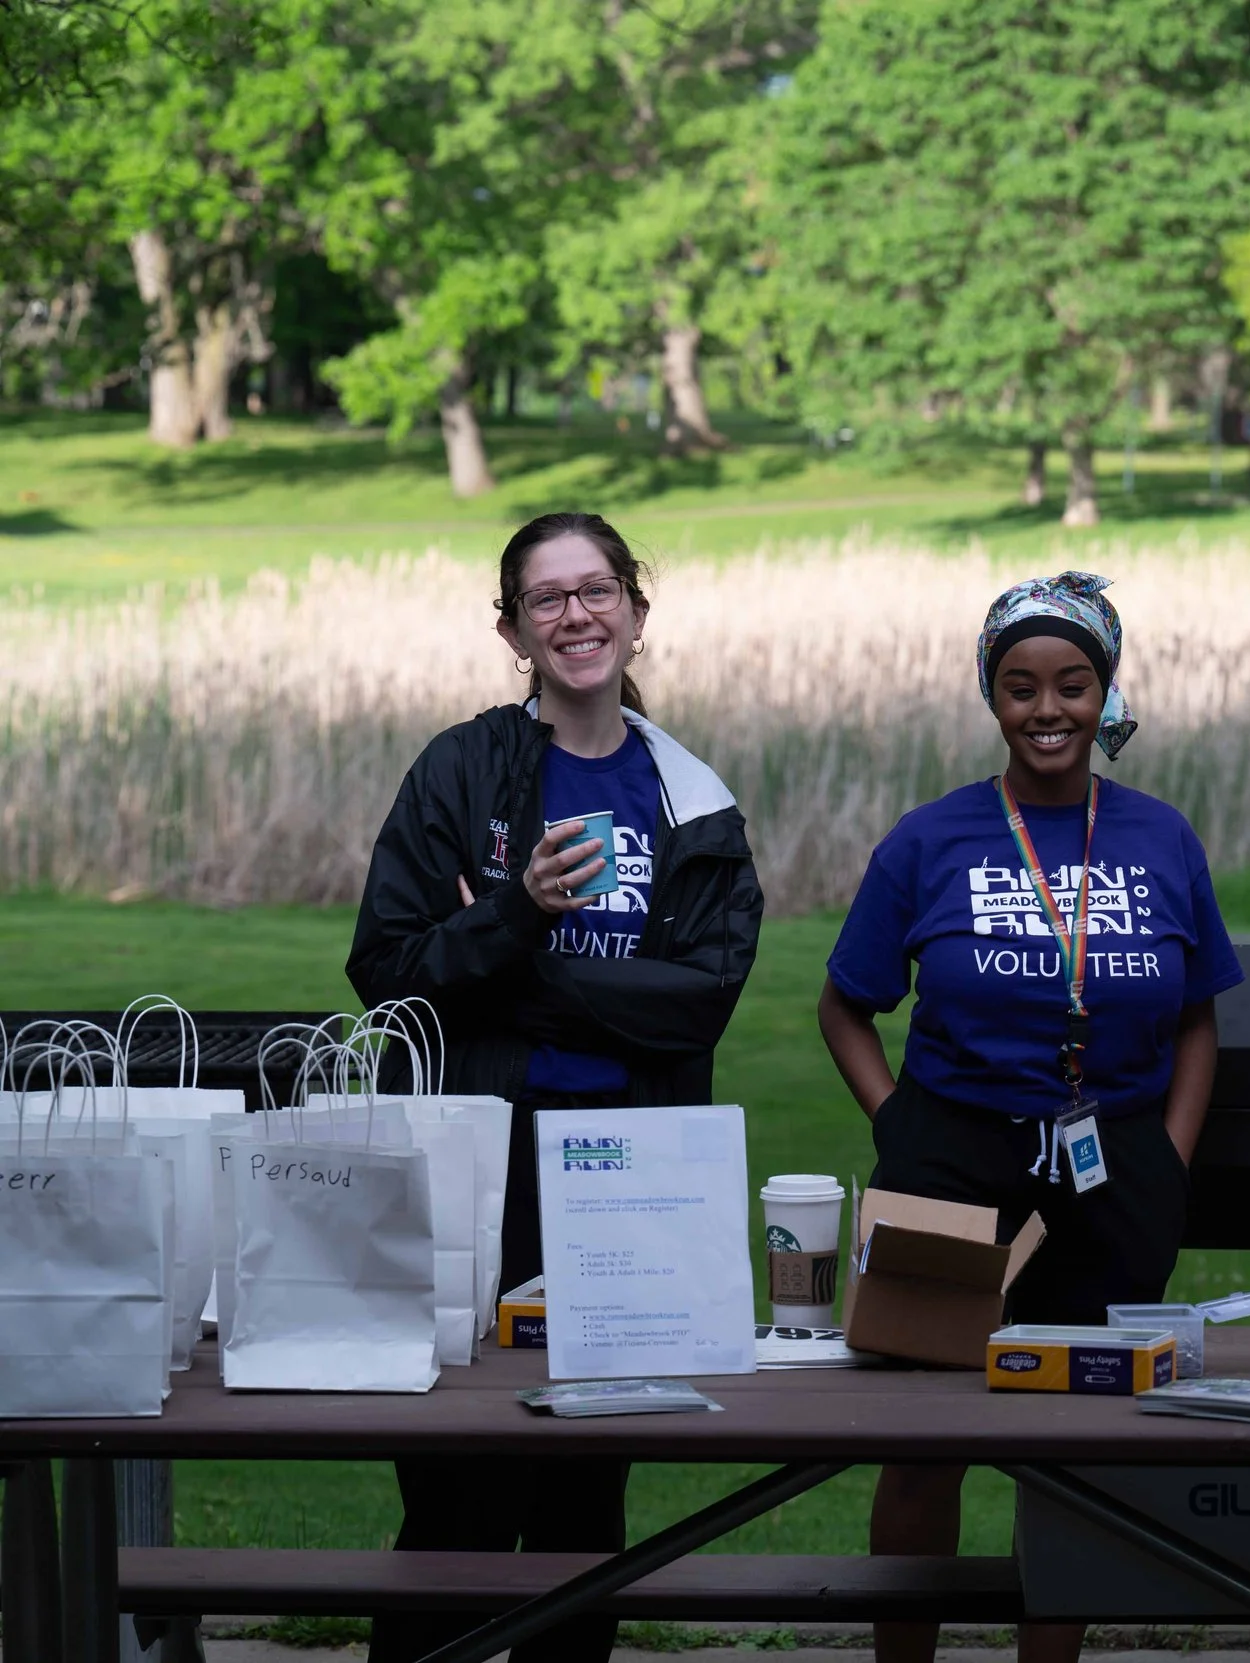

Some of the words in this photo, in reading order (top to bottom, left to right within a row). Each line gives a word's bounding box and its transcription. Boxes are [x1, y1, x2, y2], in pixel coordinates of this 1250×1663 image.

[1130, 865, 1154, 936] 2024
[973, 949, 1161, 978] VOLUTEER
[250, 1153, 351, 1188] Persaud
[1079, 1355, 1096, 1366] Pins
[1096, 1355, 1121, 1366] Safety
